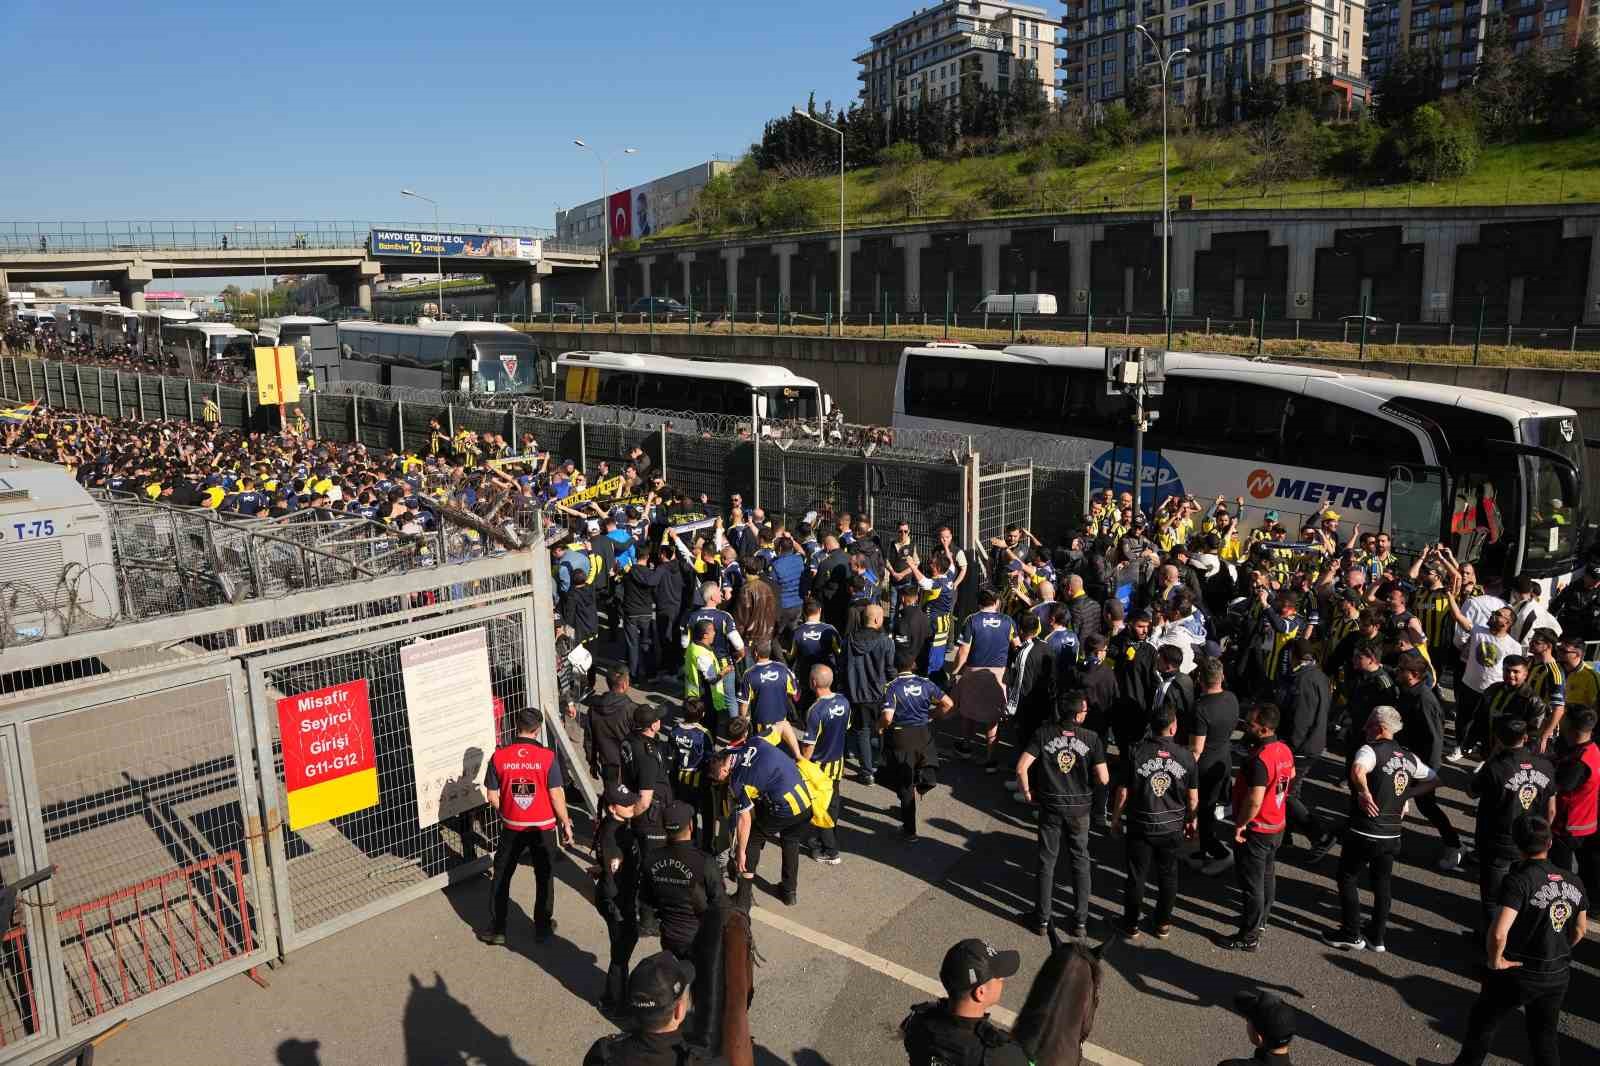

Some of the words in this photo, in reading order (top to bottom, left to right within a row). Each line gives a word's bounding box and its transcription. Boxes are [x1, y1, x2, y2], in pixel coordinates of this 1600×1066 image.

[404, 233, 420, 241] GEL
[453, 235, 464, 244] OL
[408, 241, 422, 254] 12
[14, 519, 54, 540] T-75
[297, 689, 349, 713] Misafir
[300, 708, 352, 733] Seyirci
[310, 733, 349, 755] Girişi
[305, 752, 358, 778] G11-G12
[503, 761, 520, 770] SPOR
[651, 859, 667, 876] ATLI
